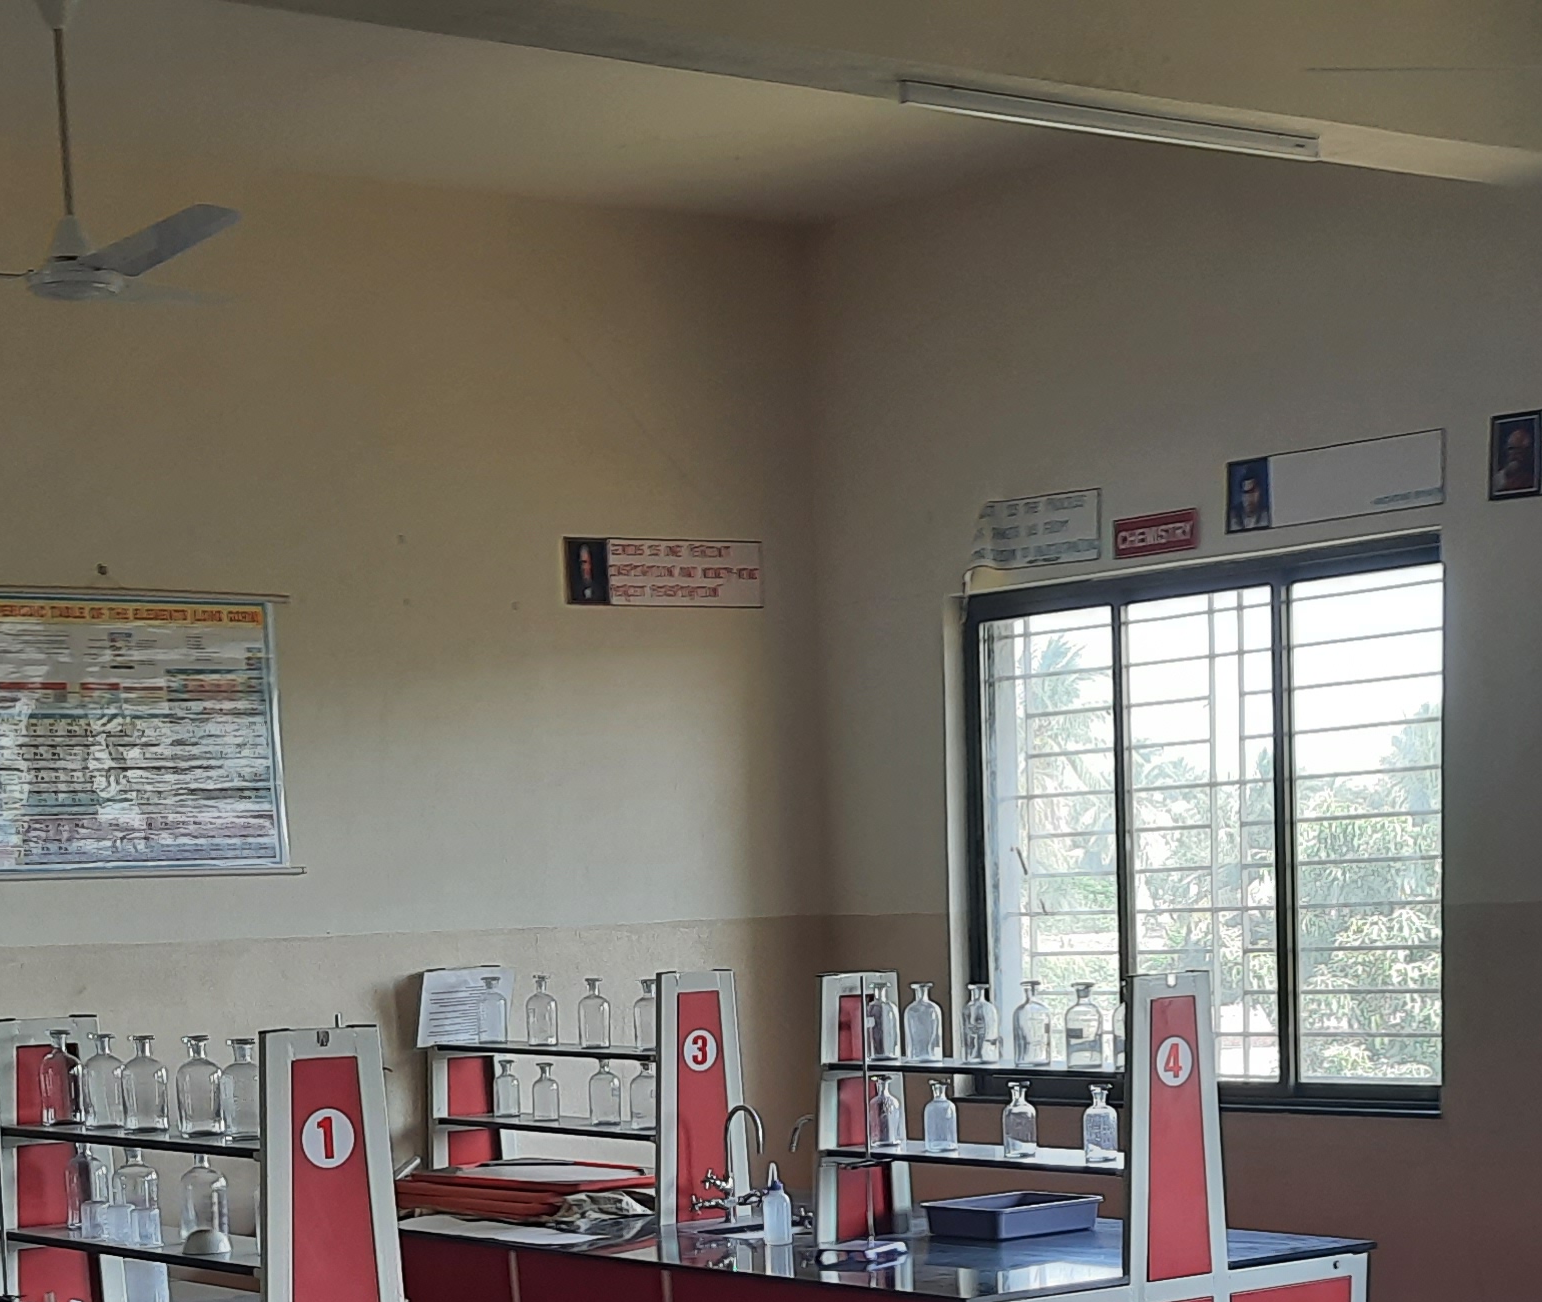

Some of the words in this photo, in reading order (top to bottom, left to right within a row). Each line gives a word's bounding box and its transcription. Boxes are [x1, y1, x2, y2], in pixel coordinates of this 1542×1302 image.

[1118, 521, 1194, 549] CHEMISTRY
[692, 1034, 709, 1065] 3
[1164, 1043, 1183, 1076] 4
[316, 1115, 335, 1158] 1
